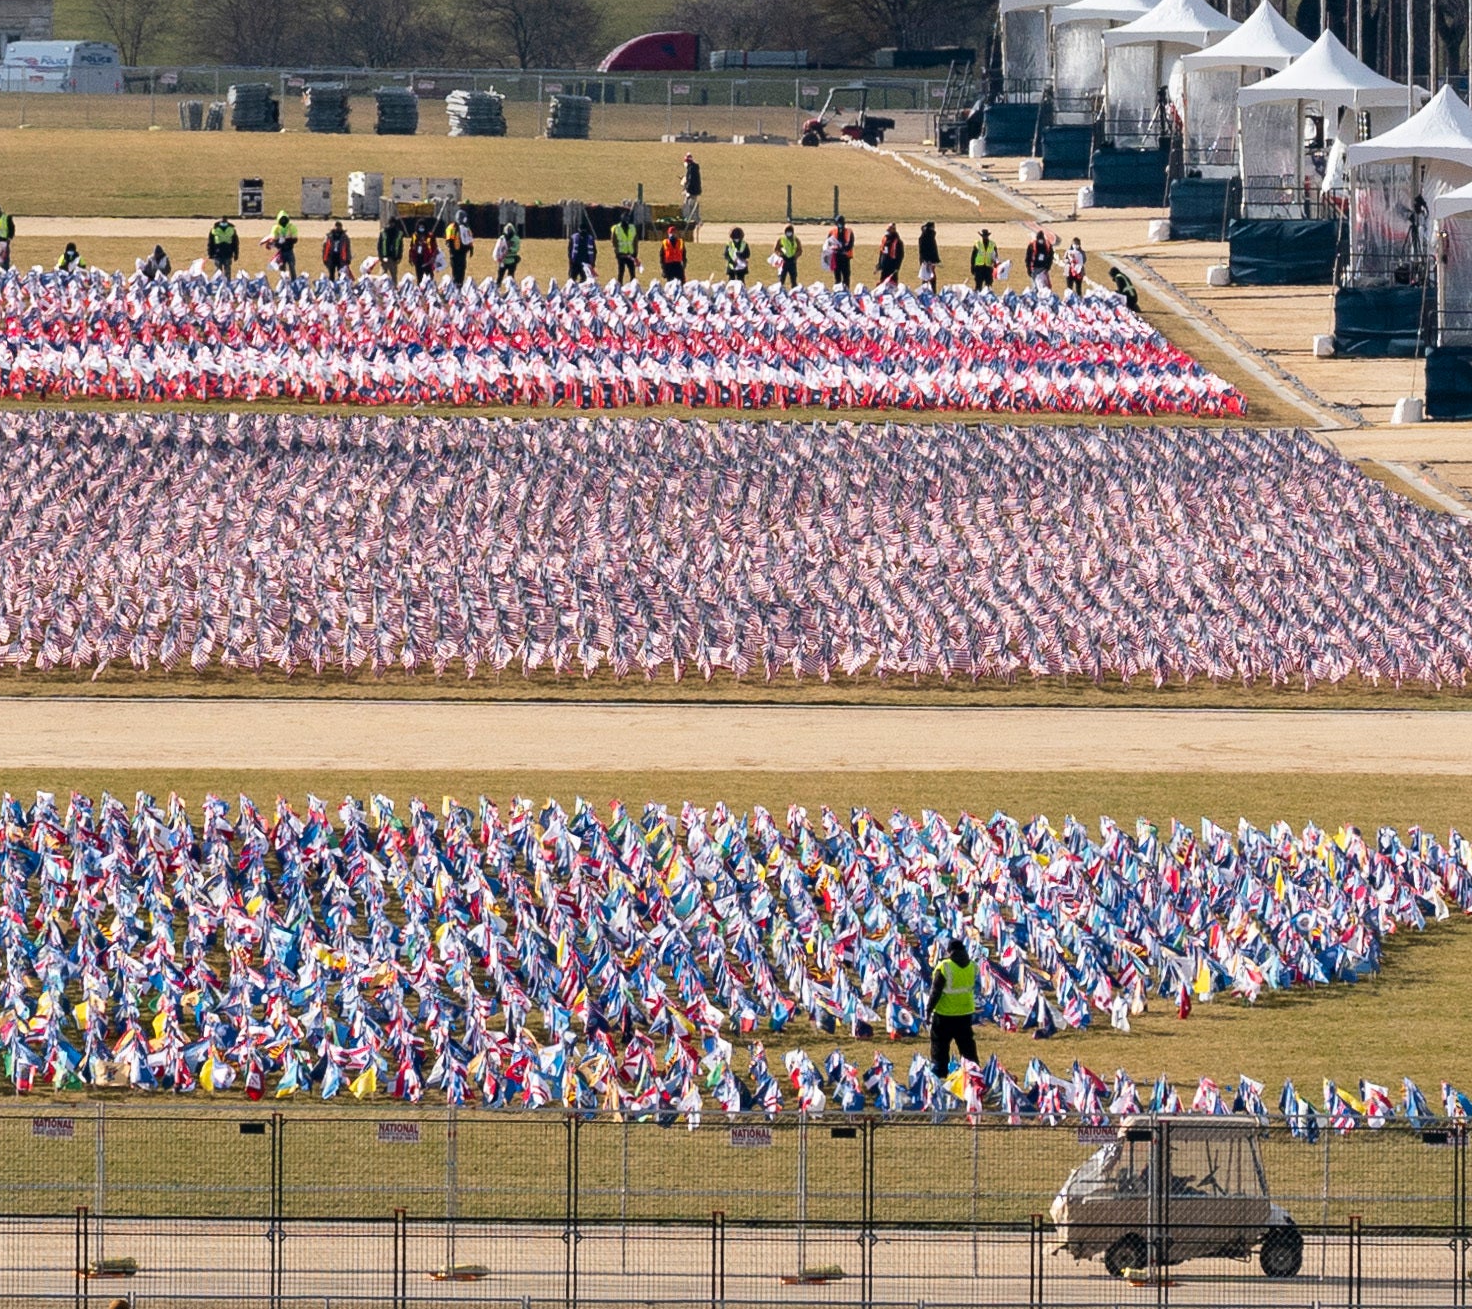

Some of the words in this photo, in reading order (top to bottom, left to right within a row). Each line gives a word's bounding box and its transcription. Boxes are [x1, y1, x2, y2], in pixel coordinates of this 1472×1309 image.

[33, 1117, 73, 1128] NATIONAL
[379, 1123, 419, 1133] NATIONAL
[1078, 1127, 1117, 1136] NATIONAL
[732, 1129, 771, 1138] NATIONAL
